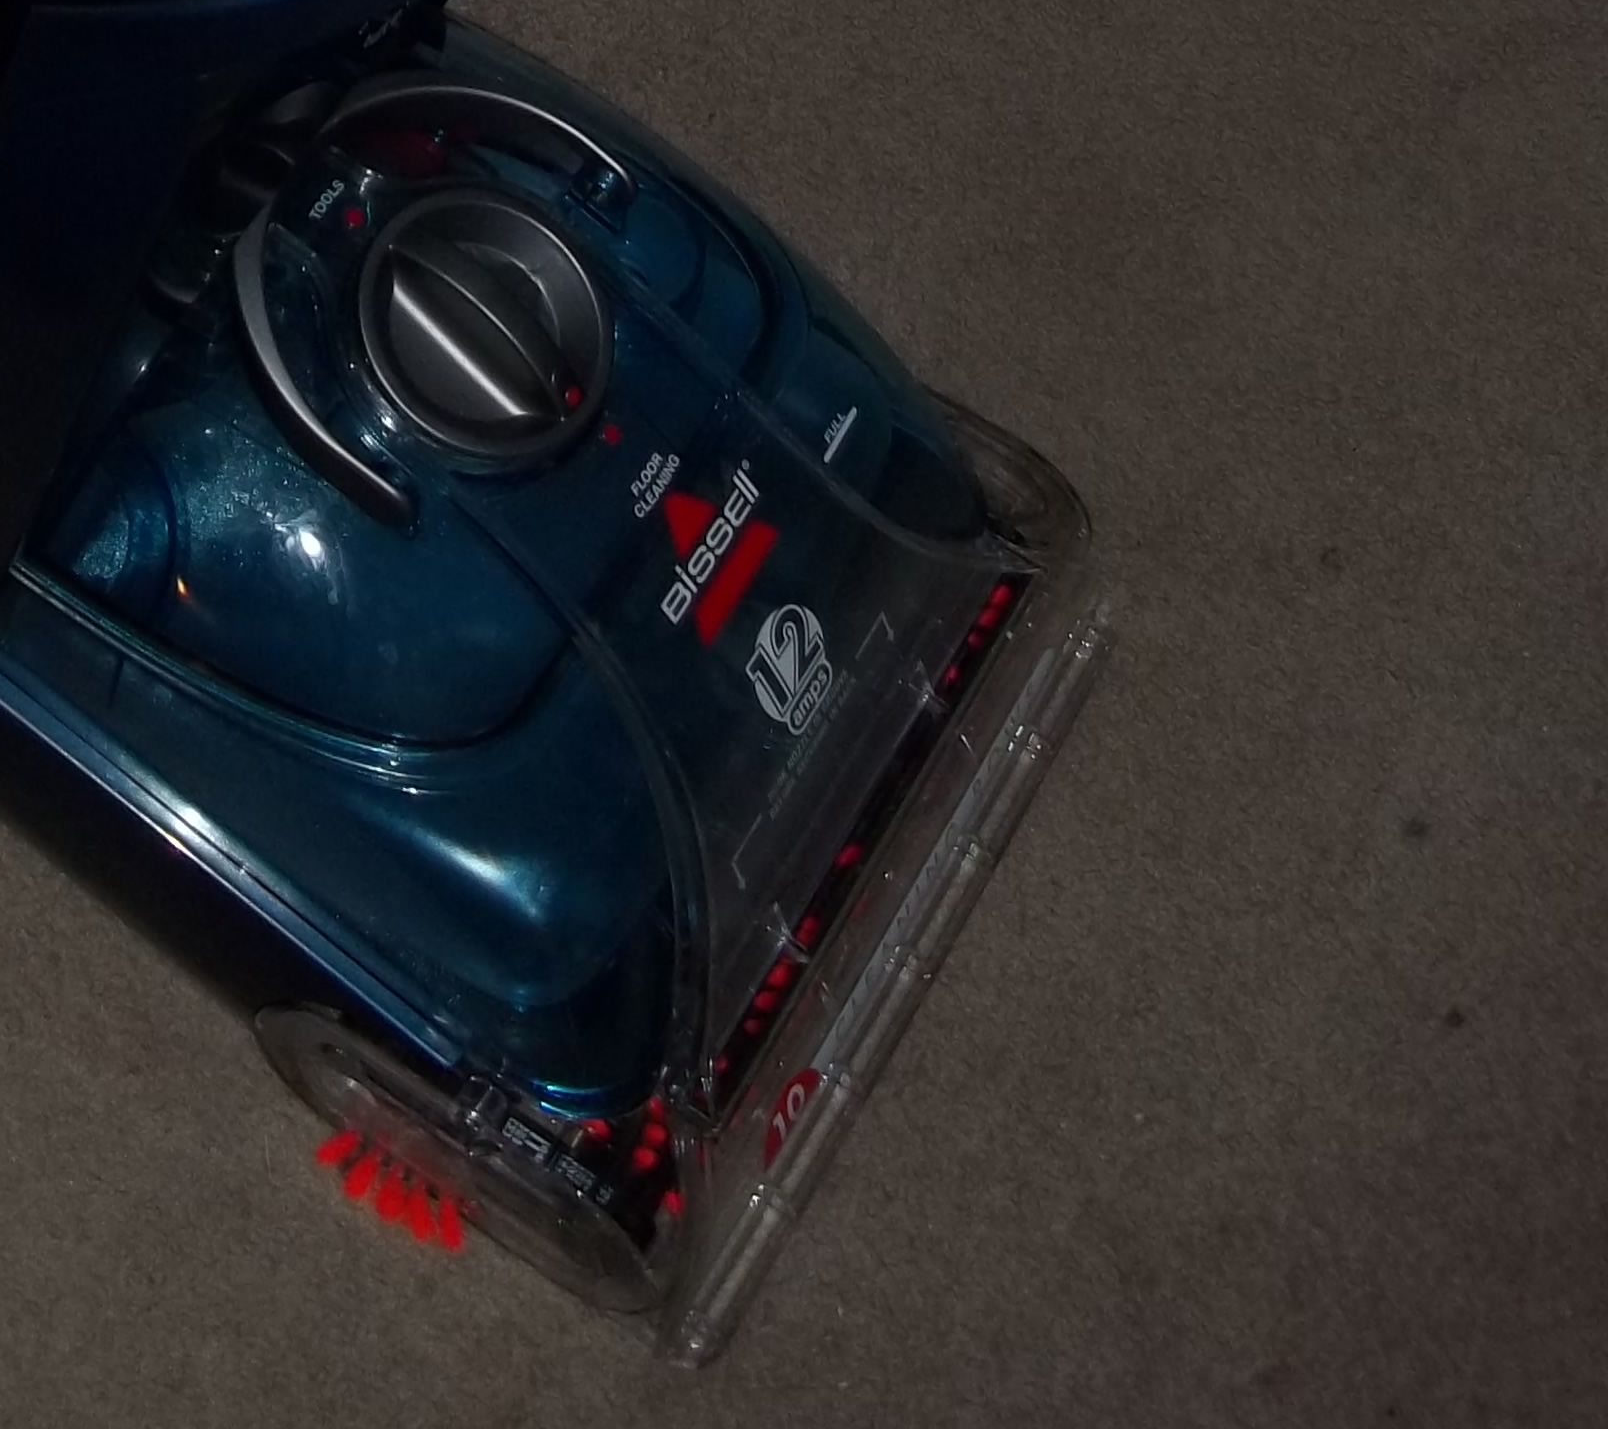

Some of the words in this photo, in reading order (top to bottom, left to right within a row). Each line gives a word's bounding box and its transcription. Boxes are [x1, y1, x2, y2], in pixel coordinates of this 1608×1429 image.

[308, 179, 344, 220] TOOLS
[824, 412, 846, 445] FULL
[630, 452, 664, 497] FLOOR
[633, 454, 680, 518] CLEANING
[745, 604, 824, 718] 12
[792, 668, 829, 728] amps
